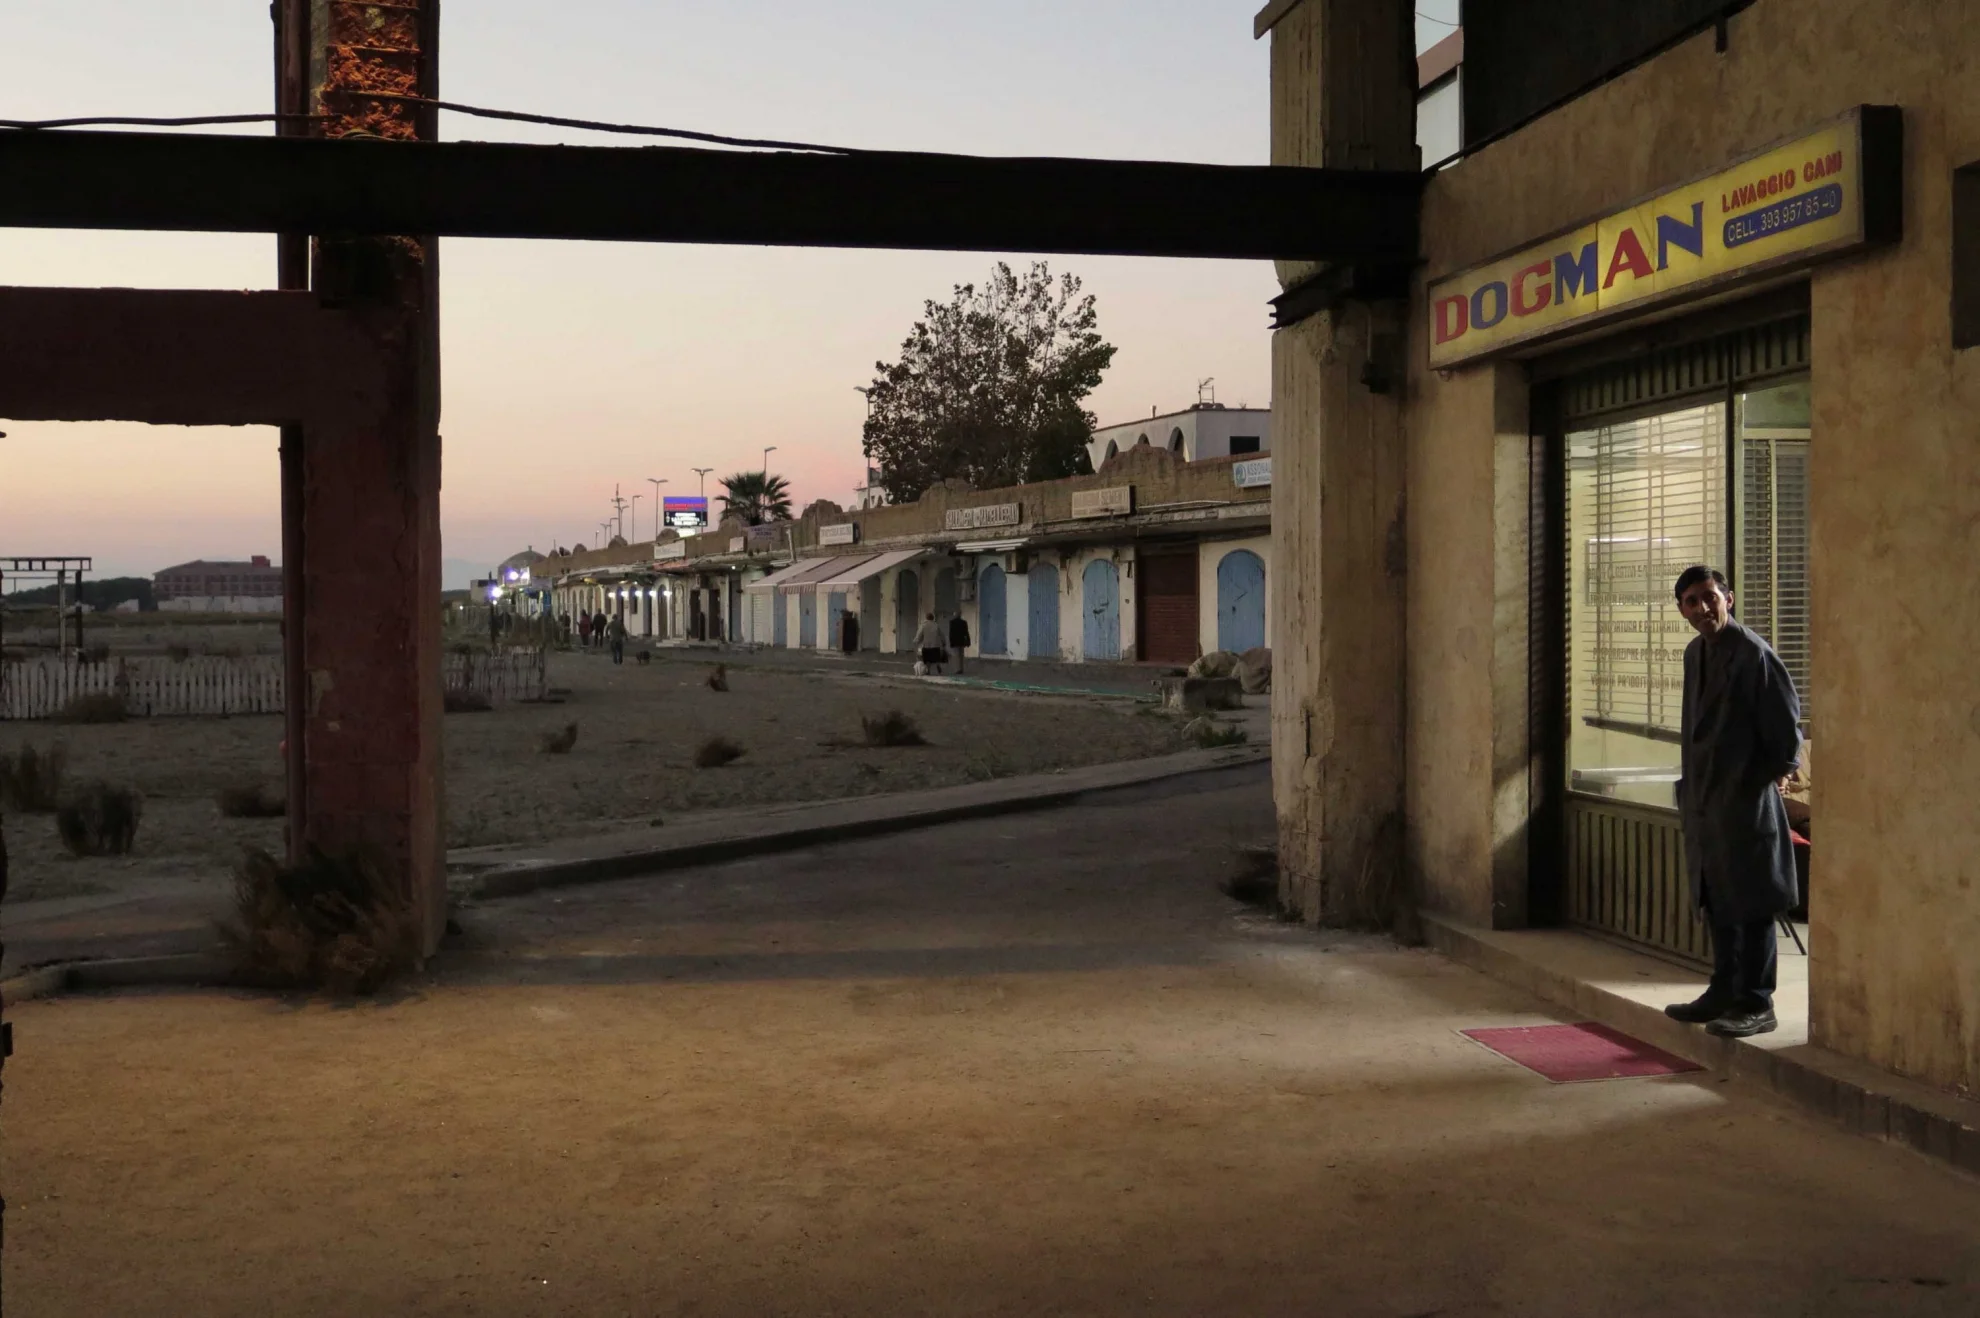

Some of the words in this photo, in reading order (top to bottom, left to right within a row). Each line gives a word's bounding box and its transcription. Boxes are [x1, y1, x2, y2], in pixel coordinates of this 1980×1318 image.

[1721, 168, 1796, 213] LAVAGGIO
[1803, 150, 1842, 183] CANI
[1727, 219, 1758, 242] CELL.
[1760, 209, 1780, 231] 393
[1782, 201, 1802, 224] 957
[1804, 195, 1820, 216] 85
[1434, 200, 1705, 346] DOGMAN
